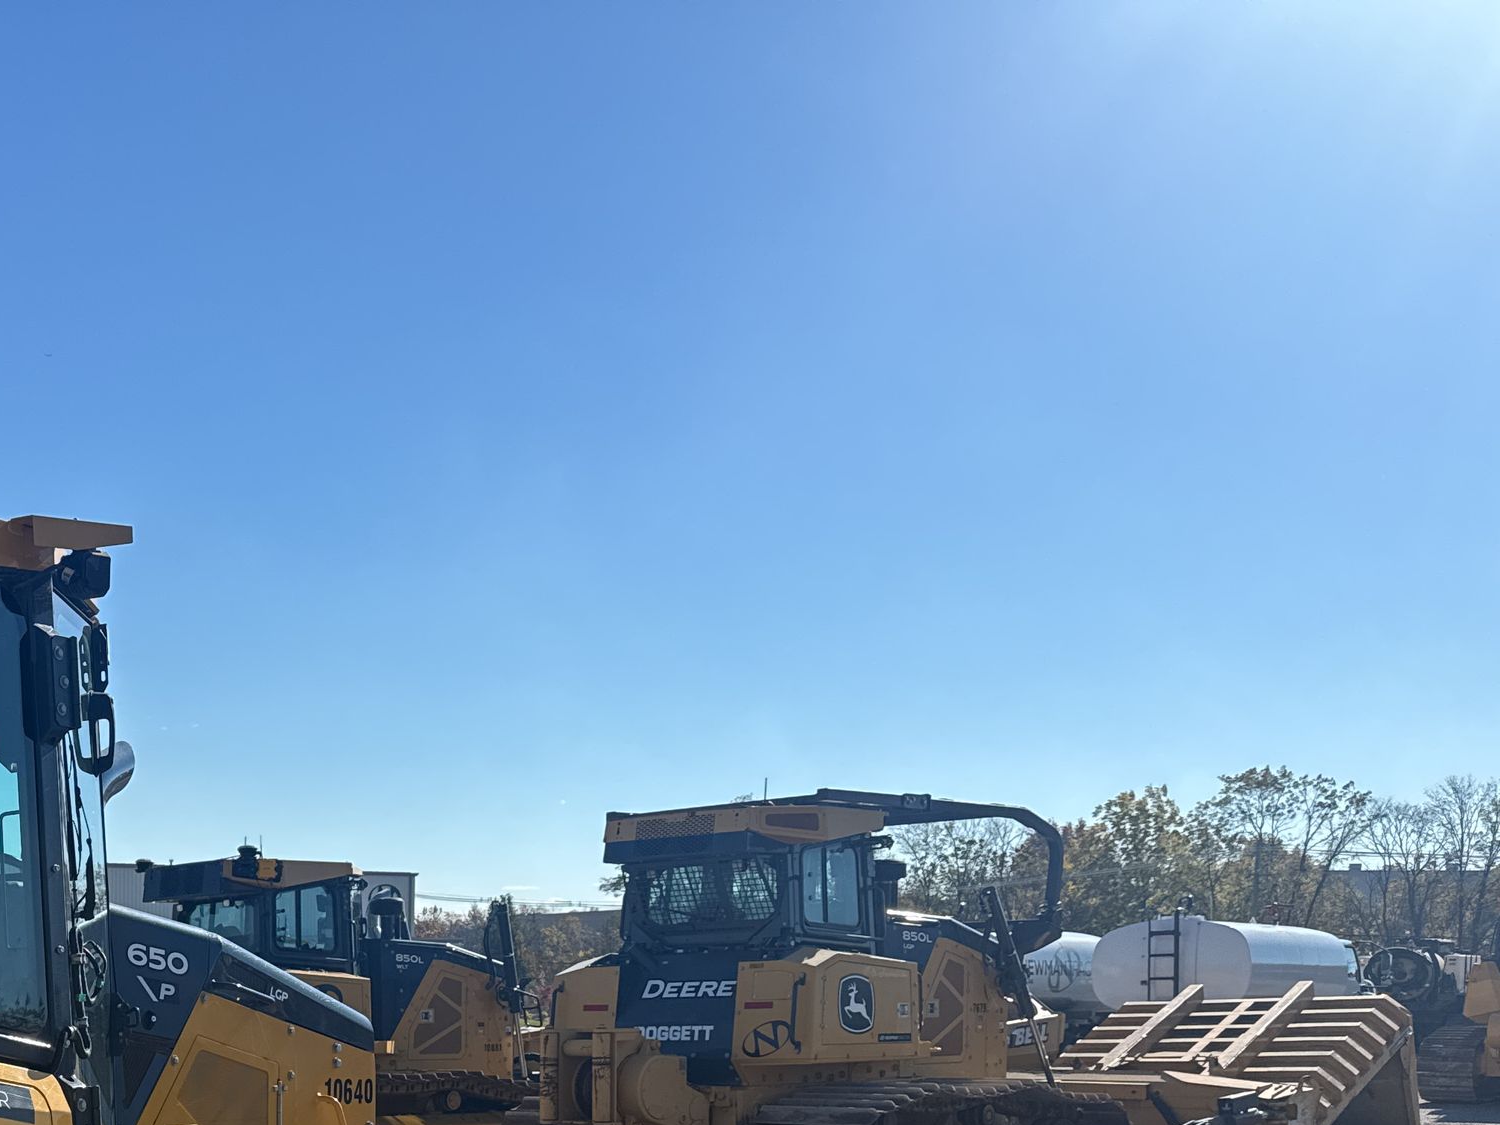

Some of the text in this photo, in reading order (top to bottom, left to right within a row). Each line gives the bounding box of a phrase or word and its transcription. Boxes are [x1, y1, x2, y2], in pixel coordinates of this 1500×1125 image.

[902, 930, 932, 943] 850L
[127, 943, 189, 975] 650
[395, 953, 424, 964] 850L
[269, 986, 289, 1001] LGP
[642, 980, 737, 998] DEERE
[325, 1078, 373, 1104] 10640
